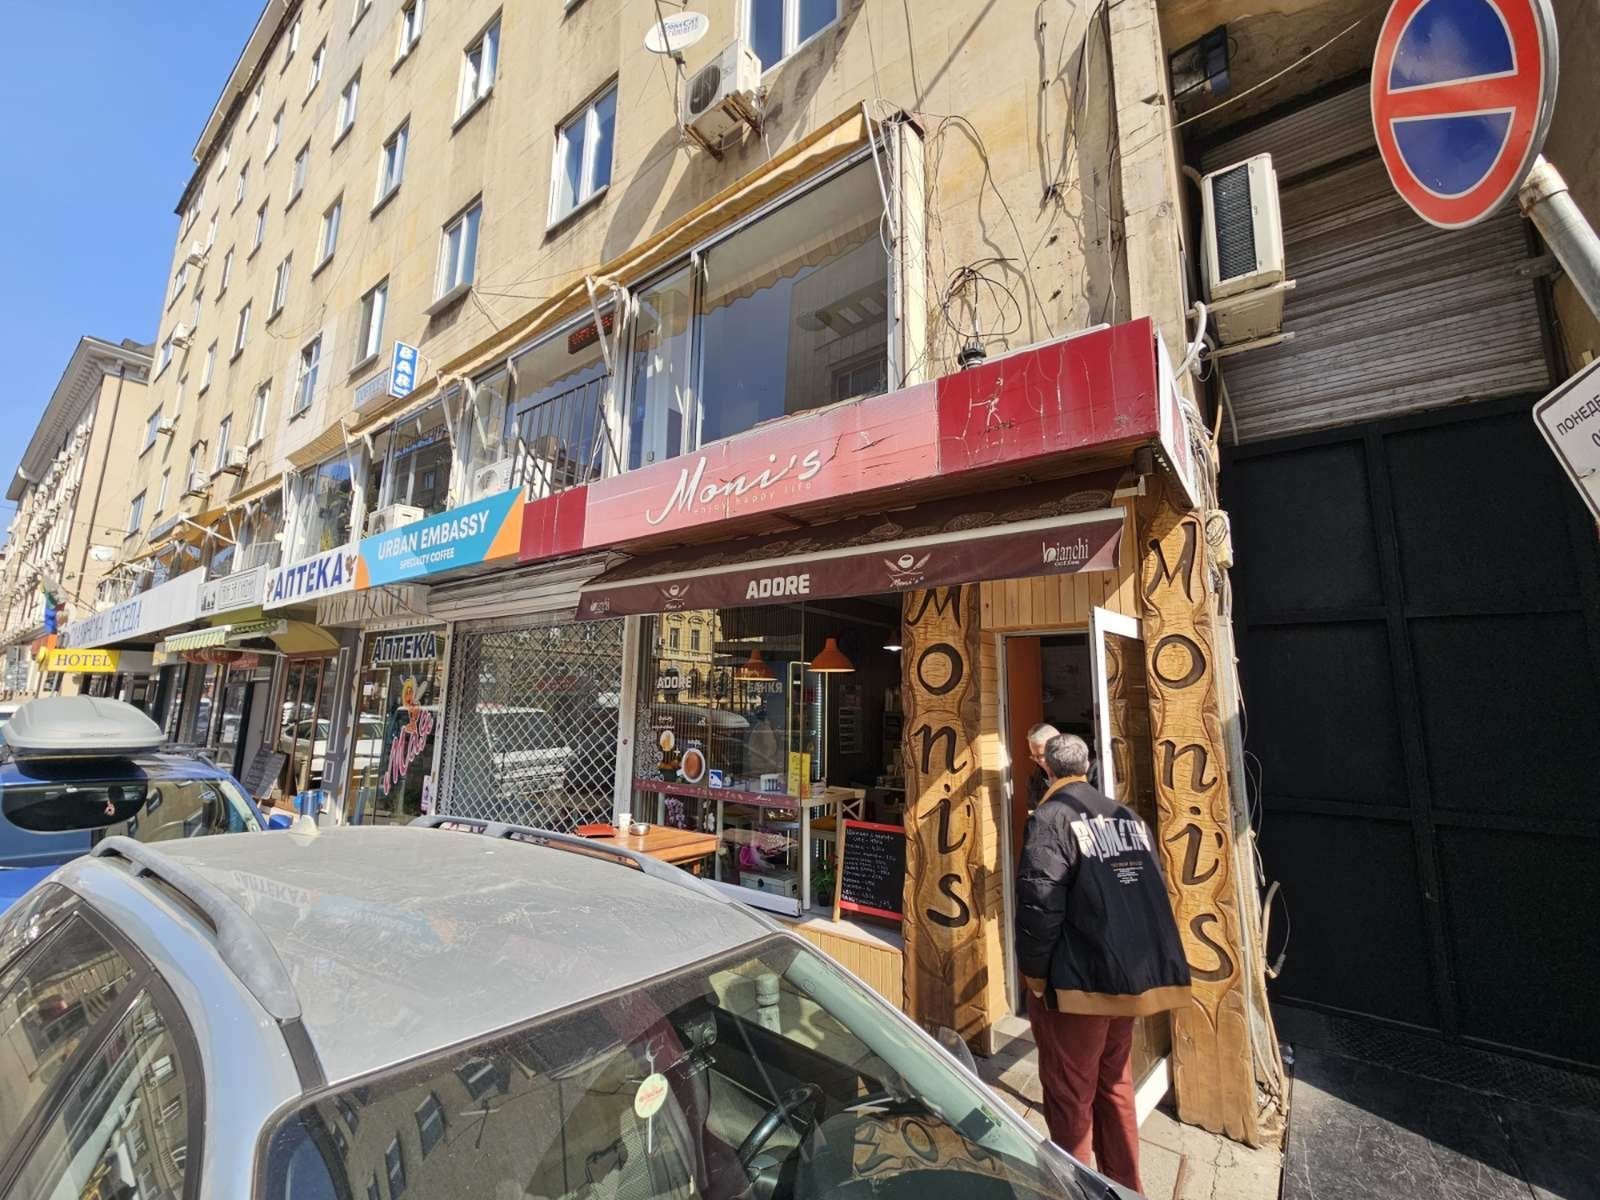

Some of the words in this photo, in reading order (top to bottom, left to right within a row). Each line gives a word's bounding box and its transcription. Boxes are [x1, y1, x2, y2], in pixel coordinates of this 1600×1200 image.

[646, 450, 822, 525] Moni's
[377, 531, 419, 561] URBAN
[420, 509, 490, 549] EMBASSY
[400, 554, 431, 571] SPECIALTY
[430, 547, 455, 563] COFFEE
[1042, 537, 1089, 563] bianchi
[273, 552, 346, 601] АПТЕКА
[746, 574, 810, 600] ADORE
[55, 654, 112, 666] HOTEL
[371, 631, 437, 663] АПТЕКА
[657, 676, 692, 689] ADORE
